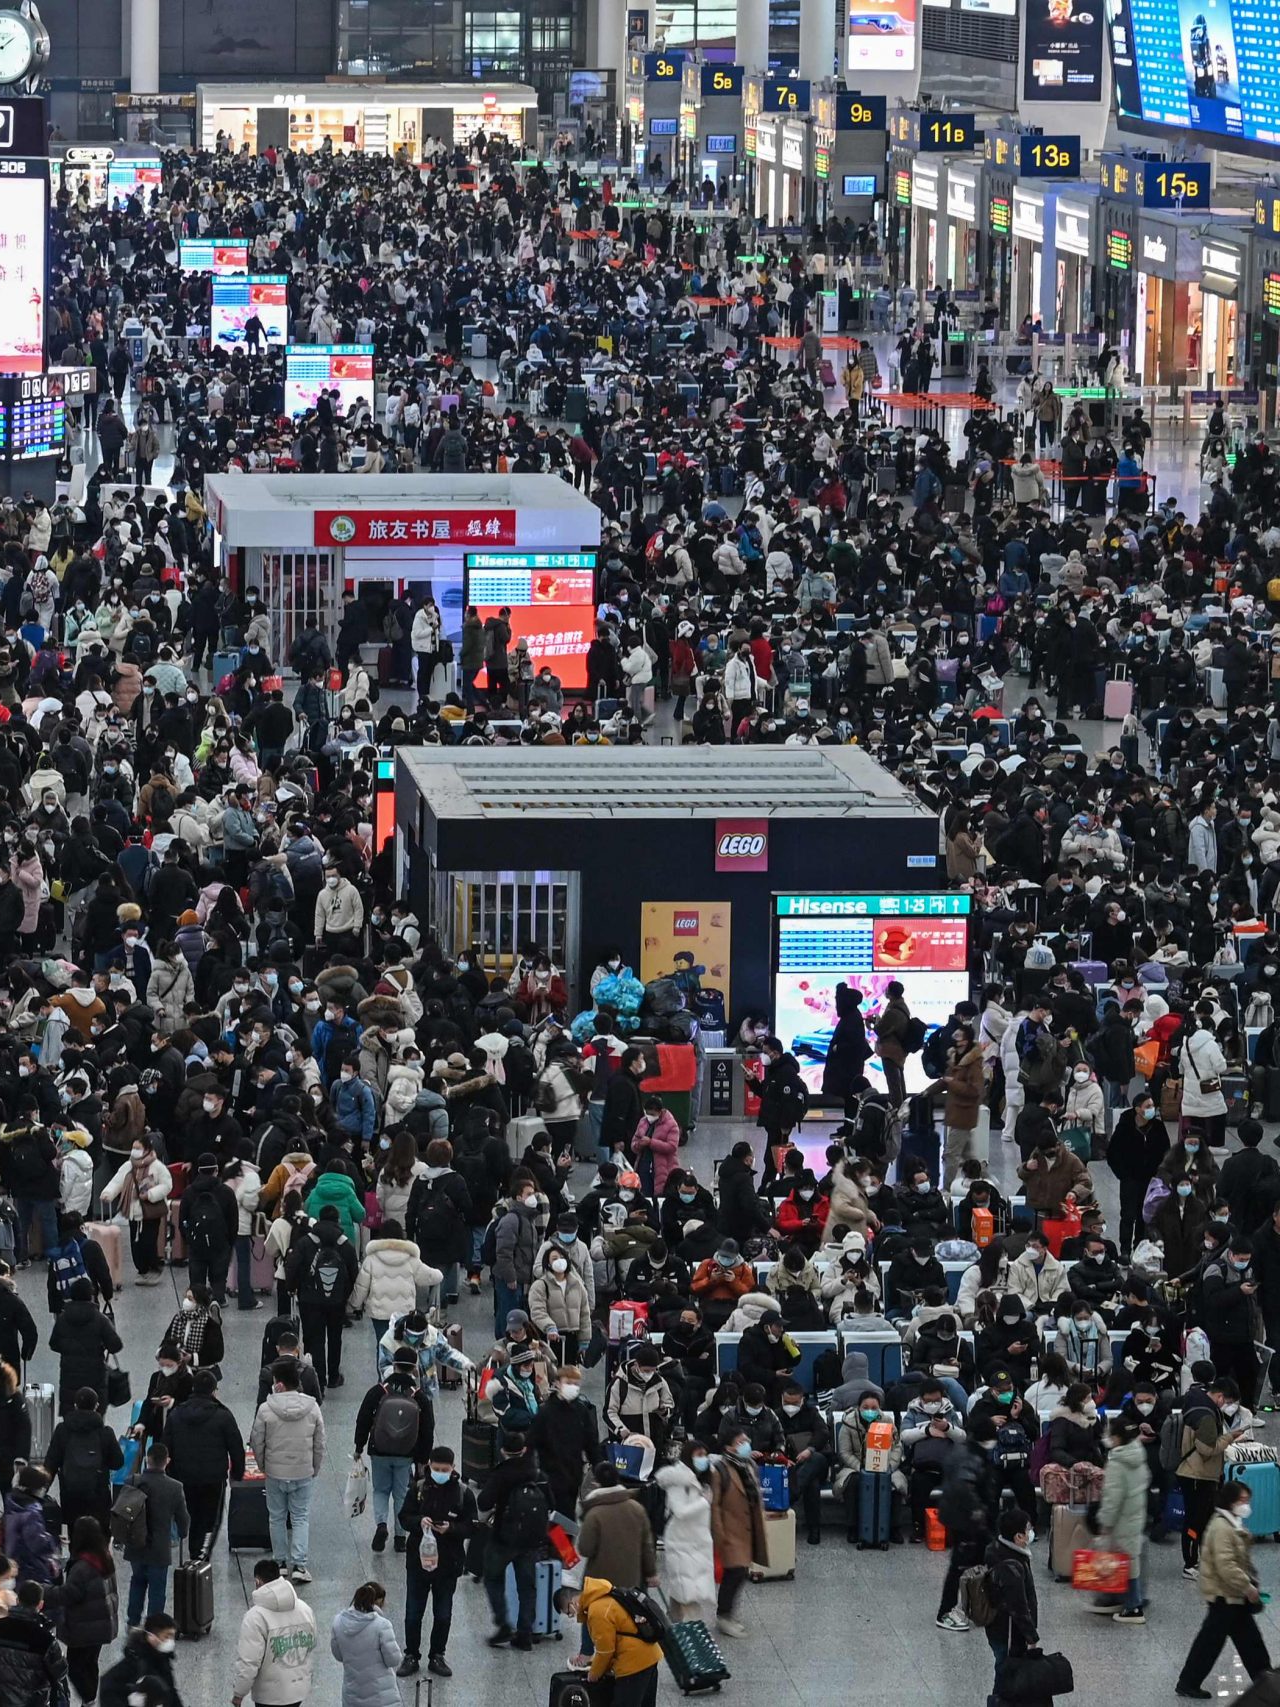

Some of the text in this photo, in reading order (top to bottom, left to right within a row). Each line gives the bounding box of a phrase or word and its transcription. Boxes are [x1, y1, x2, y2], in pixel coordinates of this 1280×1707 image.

[656, 60, 674, 76] 3B
[713, 73, 732, 89] 5B
[776, 87, 797, 105] 7B
[850, 103, 872, 123] 9B
[930, 122, 965, 143] 11B
[1031, 144, 1070, 167] 13B
[1156, 173, 1199, 197] 15B
[368, 519, 451, 540] 旅友书屋
[475, 555, 528, 566] Hisense
[718, 834, 766, 857] LEGO
[789, 897, 868, 914] Hisense
[904, 898, 925, 913] 1-25
[675, 919, 697, 928] LEGO
[872, 1434, 882, 1470] LYFEN
